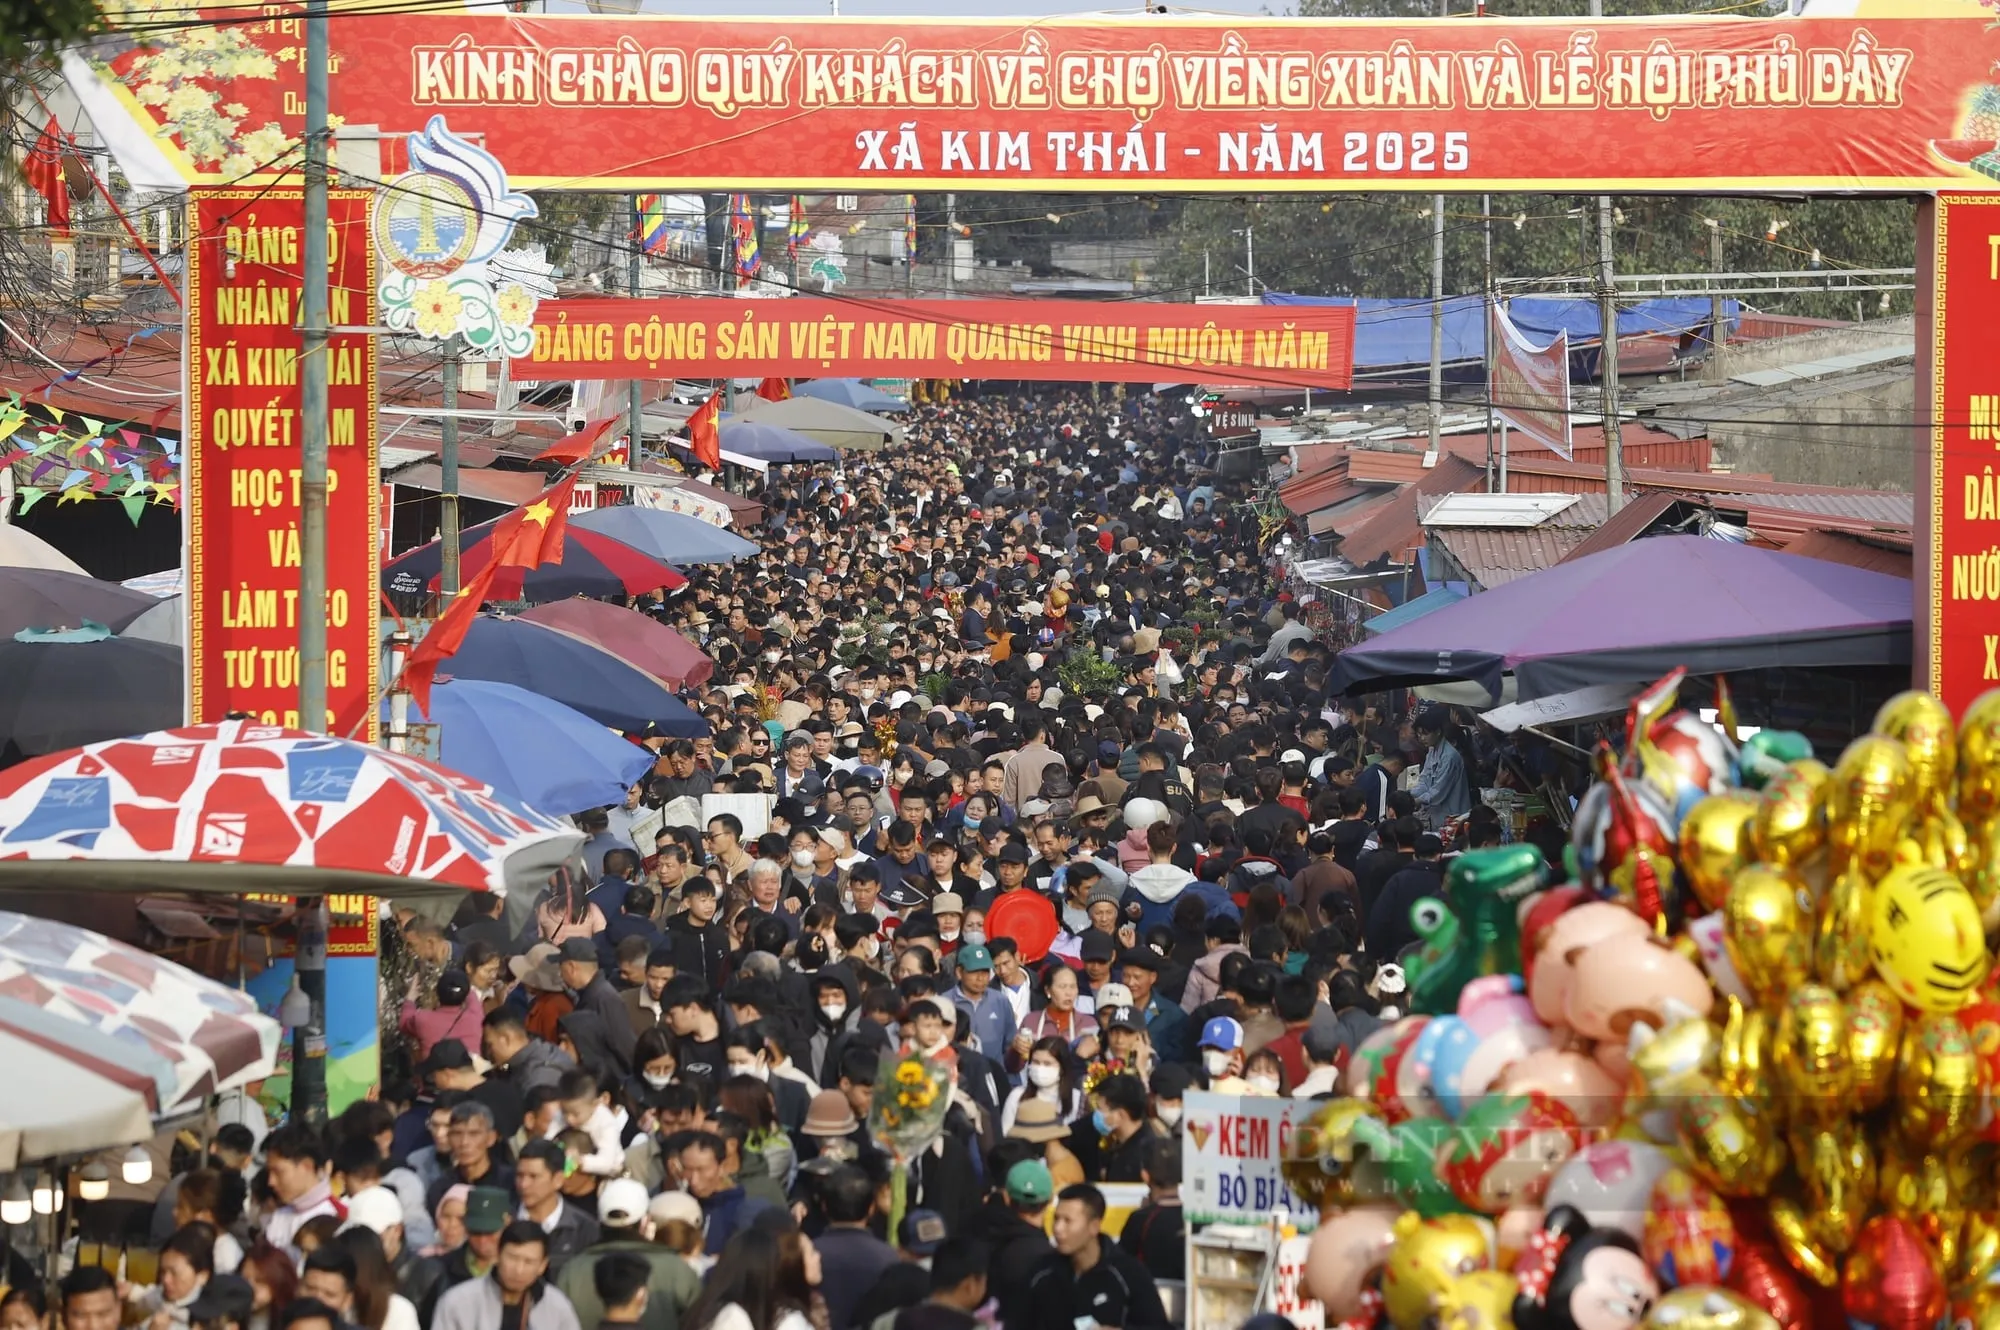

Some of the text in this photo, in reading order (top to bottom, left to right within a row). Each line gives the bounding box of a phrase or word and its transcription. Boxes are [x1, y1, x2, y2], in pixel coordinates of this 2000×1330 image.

[415, 33, 1909, 119] KÍNH CHÀO QUÝ KHÁCH VỀ CHỢ VIỀNG XUÂN VÀ LỄ HỘI PHỦ DẦY
[855, 121, 924, 171] XÃ
[940, 131, 1032, 171] KIM
[1047, 122, 1168, 172] THÁI
[1218, 123, 1325, 172] NĂM
[1343, 131, 1470, 172] 2025
[225, 213, 298, 265] ĐẢNG
[216, 279, 290, 325] NHÂN
[205, 340, 240, 385] XÃ
[247, 347, 297, 385] KIM
[532, 310, 1330, 370] ĐẢNG CỘNG SẢN VIỆT NAM QUANG VINH MUÔN NĂM
[213, 396, 295, 451] QUYẾT
[231, 468, 284, 516] HỌC
[268, 521, 302, 568] VÀ
[222, 581, 278, 628] LÀM
[223, 646, 258, 688] TƯ
[1219, 1114, 1269, 1160] KEM
[1218, 1163, 1247, 1209] BÒ
